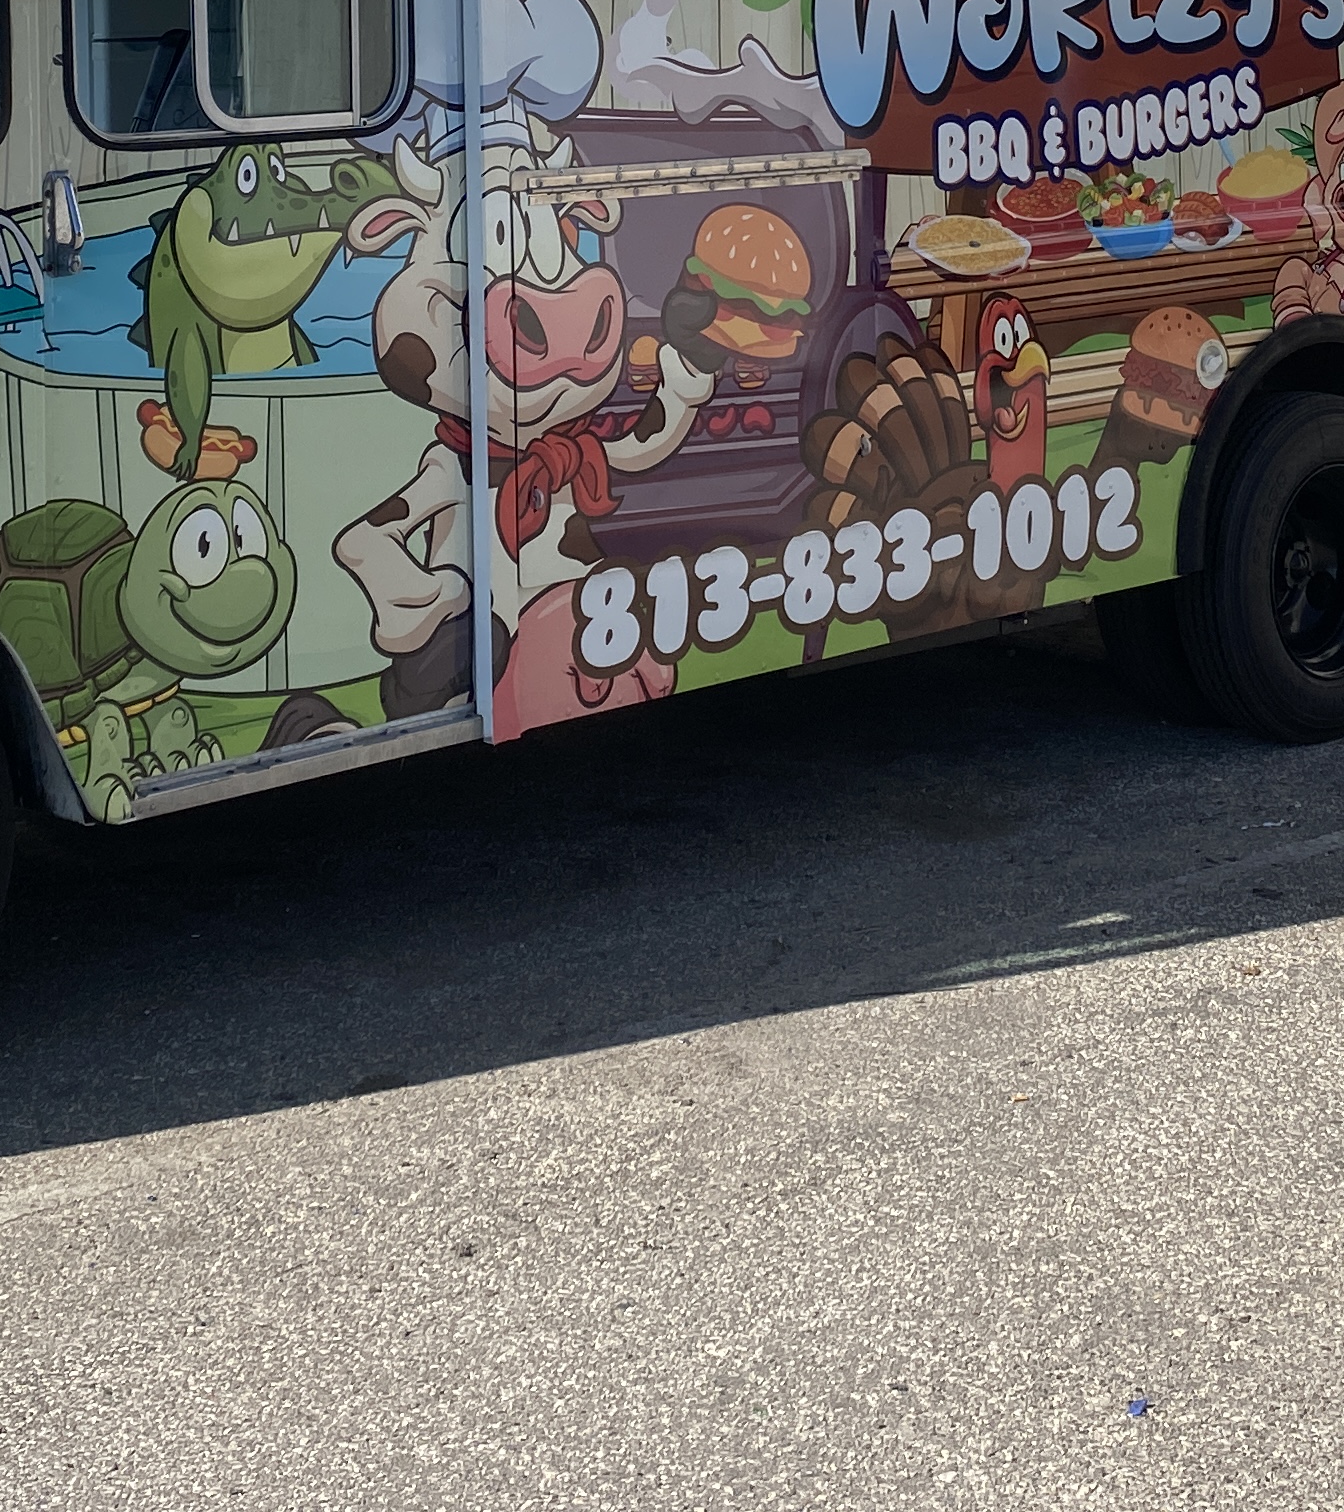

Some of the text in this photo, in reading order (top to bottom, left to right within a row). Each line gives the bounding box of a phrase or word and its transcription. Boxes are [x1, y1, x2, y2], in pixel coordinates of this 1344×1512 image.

[937, 116, 1032, 185] BBQ
[1077, 65, 1263, 167] BURGERS
[580, 466, 1138, 668] 813-833-1012
